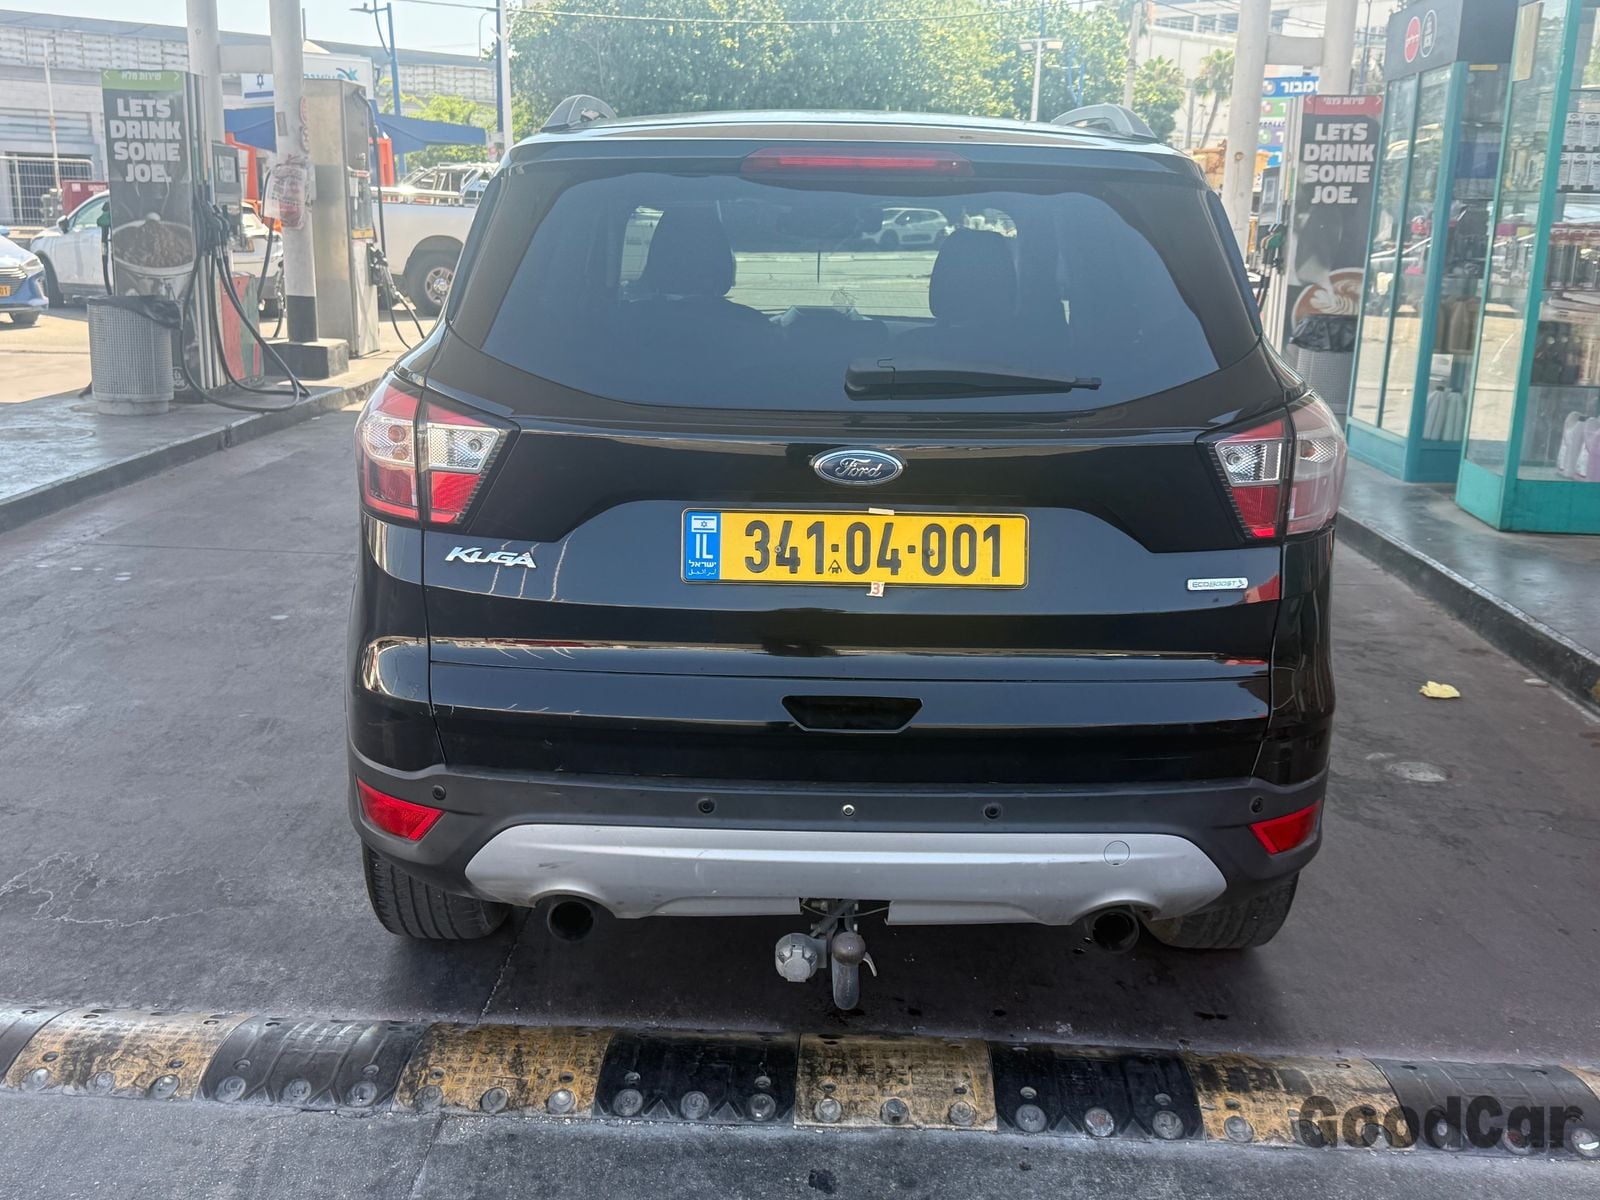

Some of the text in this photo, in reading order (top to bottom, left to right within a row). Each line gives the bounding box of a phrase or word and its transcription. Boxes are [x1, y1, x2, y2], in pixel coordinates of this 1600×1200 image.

[117, 98, 171, 118] LETS
[110, 120, 182, 140] DRINK
[1315, 123, 1368, 141] LETS
[114, 141, 180, 161] SOME
[1304, 144, 1376, 162] DRINK
[125, 163, 172, 183] JOE.
[1305, 164, 1371, 183] SOME
[1311, 186, 1359, 204] JOE.
[835, 458, 883, 478] Ford
[695, 534, 714, 559] IL
[445, 546, 537, 569] KUGA
[688, 560, 717, 568] ישראל
